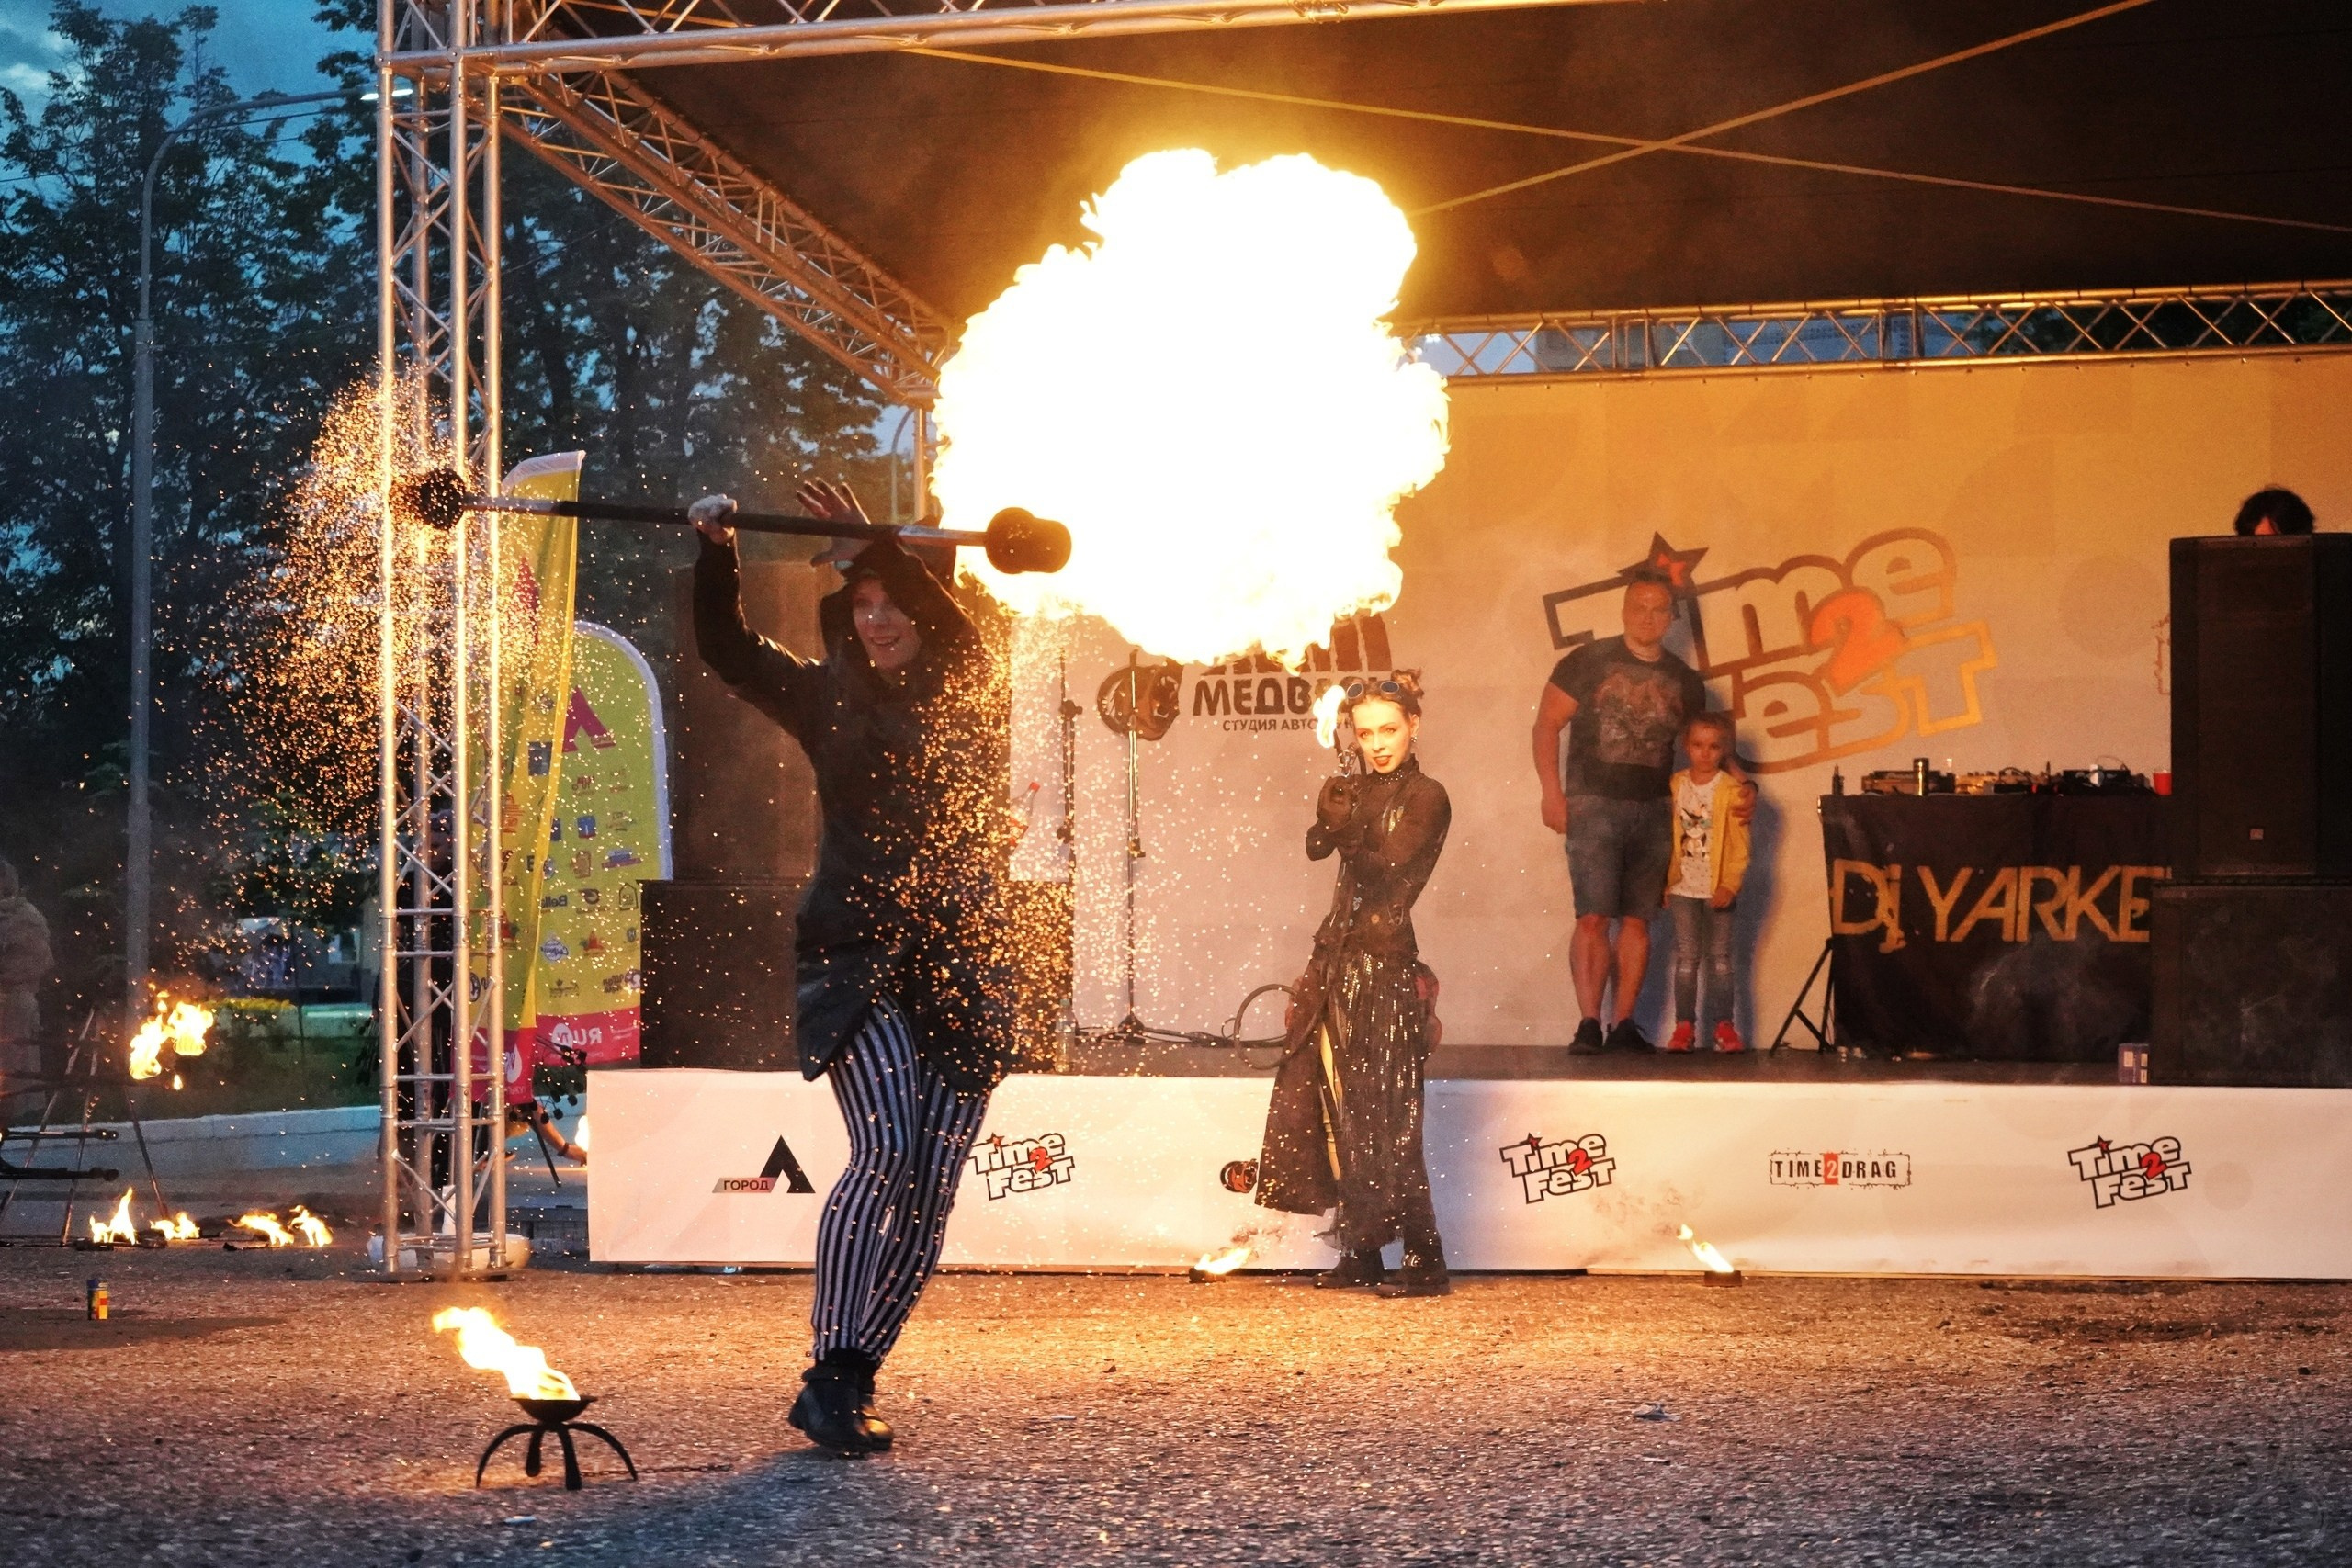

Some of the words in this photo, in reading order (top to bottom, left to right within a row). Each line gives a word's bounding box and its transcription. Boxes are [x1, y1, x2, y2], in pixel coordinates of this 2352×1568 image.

[1810, 586, 1898, 696] 2
[1193, 676, 1378, 716] МЕДВ
[1223, 718, 1277, 733] СТУДИЯ
[1917, 865, 2172, 942] YARKE
[967, 1133, 1066, 1175] Time
[1030, 1146, 1054, 1172] 2
[1499, 1132, 1607, 1178] Time
[1568, 1147, 1594, 1176] 2
[2067, 1135, 2181, 1182] Time
[2141, 1152, 2167, 1180] 2
[723, 1179, 770, 1190] ГОРОД
